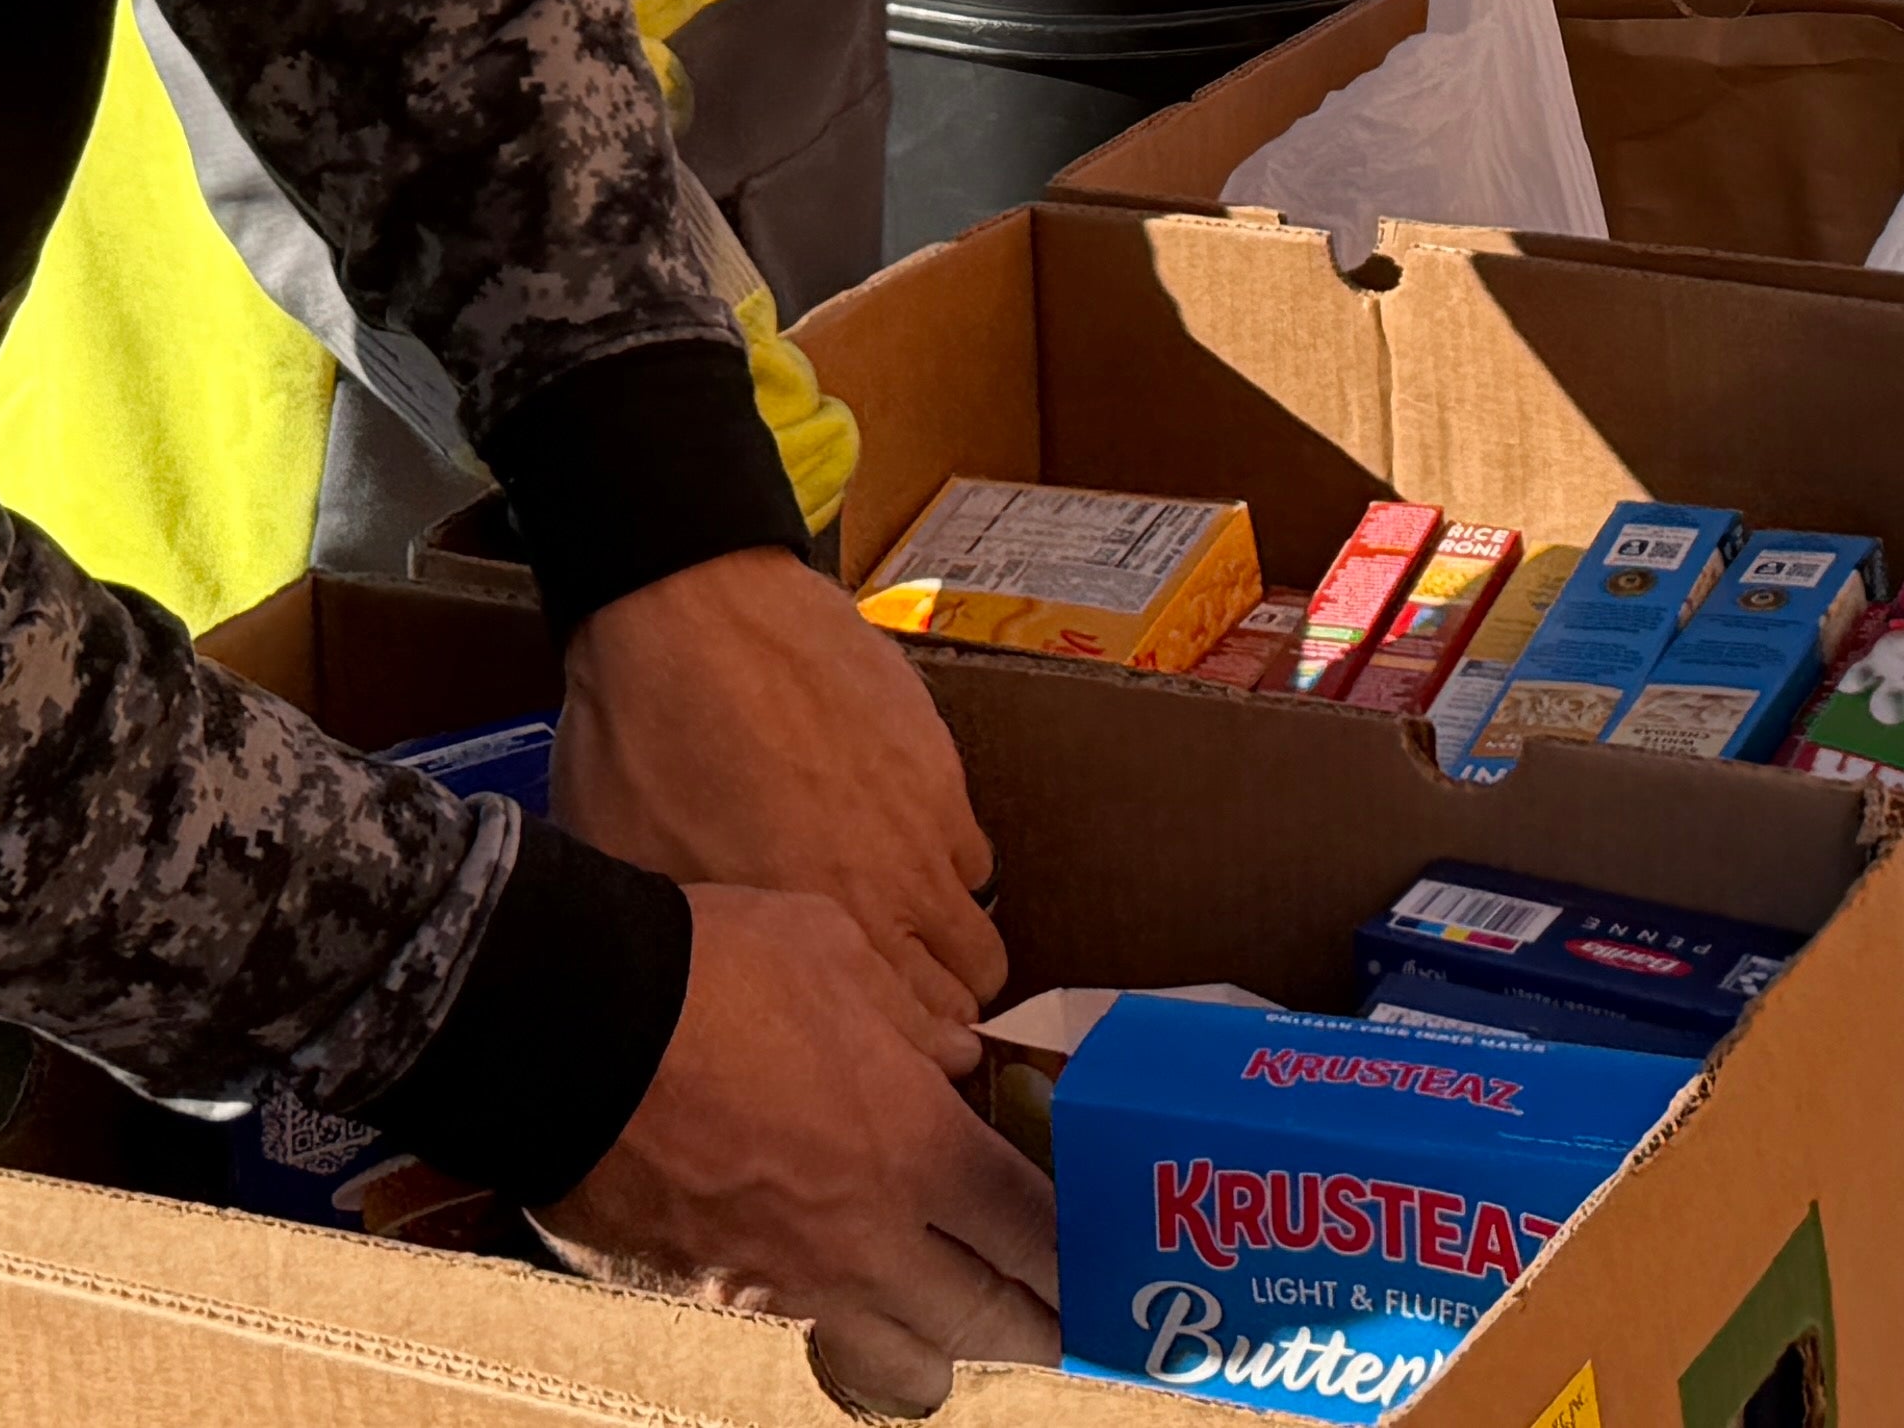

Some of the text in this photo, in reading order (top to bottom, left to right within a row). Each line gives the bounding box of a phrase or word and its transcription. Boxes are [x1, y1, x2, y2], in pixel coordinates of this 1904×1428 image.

[1437, 538, 1503, 558] RONI
[1446, 523, 1510, 544] RICE
[1581, 915, 1713, 956] PENNE
[1240, 1047, 1524, 1117] KRUSTEAZ
[1250, 1276, 1339, 1308] LIGHT
[1350, 1284, 1375, 1312] &
[1131, 1280, 1449, 1406] Butter
